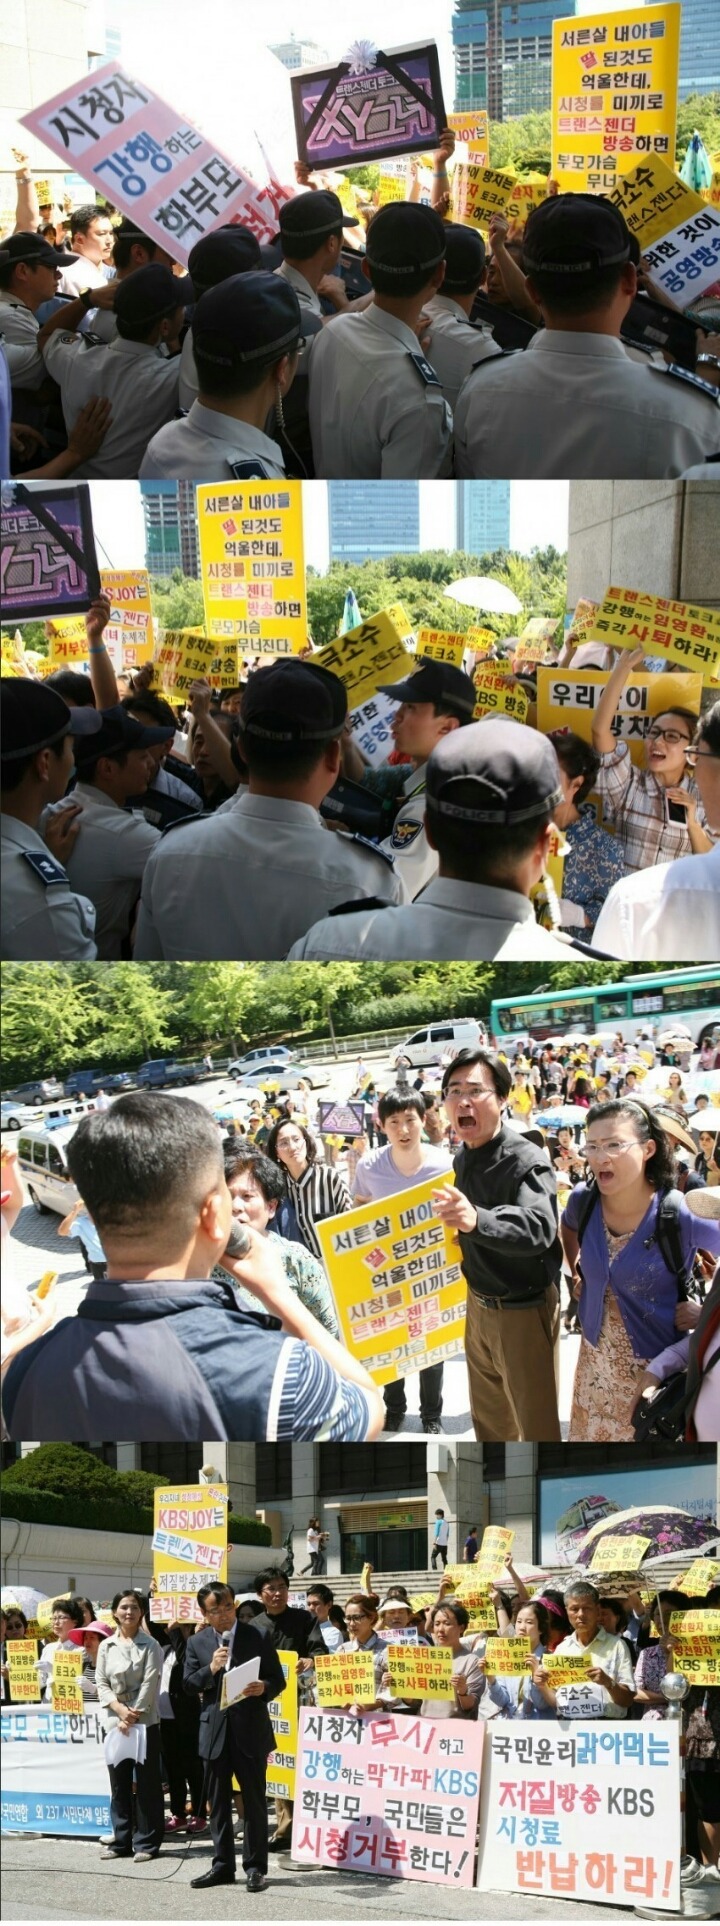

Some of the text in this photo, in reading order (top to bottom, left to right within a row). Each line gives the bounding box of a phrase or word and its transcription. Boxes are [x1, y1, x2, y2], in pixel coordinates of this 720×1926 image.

[561, 21, 666, 47] 서른살 내아들
[580, 48, 653, 69] 딸 된것도
[336, 77, 378, 97] 트랜스젠더
[581, 72, 651, 90] 억울한데,
[49, 72, 149, 149] 시청자
[613, 94, 663, 111] 미끼로
[558, 117, 636, 133] 트랜스젠더
[602, 135, 669, 153] 방송하면
[92, 129, 204, 197] 강행하는
[557, 154, 617, 170] 부모가슴
[482, 169, 513, 191] 망치는
[610, 166, 655, 209] 극소수
[154, 154, 243, 240] 학부모
[480, 190, 506, 207] 토크쇼
[642, 213, 720, 269] 위한 것이
[205, 493, 290, 513] 서른살 내아들
[18, 516, 46, 532] 토크
[222, 517, 282, 536] 딸 된것도
[224, 540, 283, 557] 억울한데,
[252, 561, 294, 577] 미끼로
[116, 585, 148, 601] JOY는
[208, 583, 274, 599] 트랜스젠더
[247, 602, 302, 618] 방송하면
[607, 586, 687, 617] 트랜스젠더
[211, 620, 261, 635] 부모가슴
[602, 601, 652, 623] 강행하는
[654, 613, 707, 640] 임영환
[186, 635, 215, 656] 망치는
[238, 639, 293, 655] 무너진다.
[319, 622, 381, 668] 극소수
[420, 631, 465, 647] 트랜스젠더
[596, 619, 627, 636] 즉각
[627, 623, 718, 664] 사퇴하라!
[424, 646, 457, 662] 토크쇼
[184, 657, 207, 673] 토크쇼
[476, 691, 498, 707] BS
[504, 695, 526, 716] 방송
[552, 682, 648, 712] 우리이
[348, 701, 378, 734] 위한
[444, 802, 499, 820] POLICE
[334, 1199, 441, 1253] 서른살 내아
[392, 1225, 445, 1261] 된것도
[371, 1251, 447, 1289] 억울한데,
[412, 1265, 461, 1299] 미끼로
[352, 1297, 439, 1340] 트랜스젠더
[158, 1507, 224, 1530] KBS JOY는
[594, 1546, 643, 1560] KBS 방송
[151, 1597, 176, 1619] 즉각
[479, 1609, 495, 1620] 방송
[670, 1622, 705, 1634] 성전환자
[8, 1642, 35, 1653] 트랜스젠더
[388, 1646, 452, 1660] 트랜스젠더 토크쇼
[674, 1645, 713, 1657] 성전환자
[10, 1654, 35, 1666] 저질방송
[315, 1654, 373, 1668] 트랜스젠더 토크쇼
[389, 1661, 443, 1675] 강행하는 김인규
[674, 1659, 701, 1672] KBS
[56, 1665, 77, 1678] 토크쇼
[317, 1670, 341, 1682] 강행하는
[341, 1667, 367, 1681] 임영환
[58, 1684, 77, 1699] 즉각
[318, 1683, 374, 1698] 즉각 사퇴하라!
[560, 1685, 593, 1701] 극소수
[304, 1715, 465, 1755] 시청자 무시하고
[492, 1735, 577, 1768] 국민윤리
[302, 1749, 479, 1798] 강행하는 막가파 KBS
[499, 1780, 655, 1817] 저질방송 KBS
[36, 1804, 44, 1820] 외
[46, 1805, 60, 1820] 237
[62, 1805, 93, 1825] 시민단체
[94, 1807, 110, 1826] 일동
[302, 1789, 468, 1838] 학부모, 국민들은
[496, 1815, 562, 1847] 시청료
[297, 1825, 470, 1879] 시청거부한다!
[516, 1850, 674, 1899] 반납하라!
